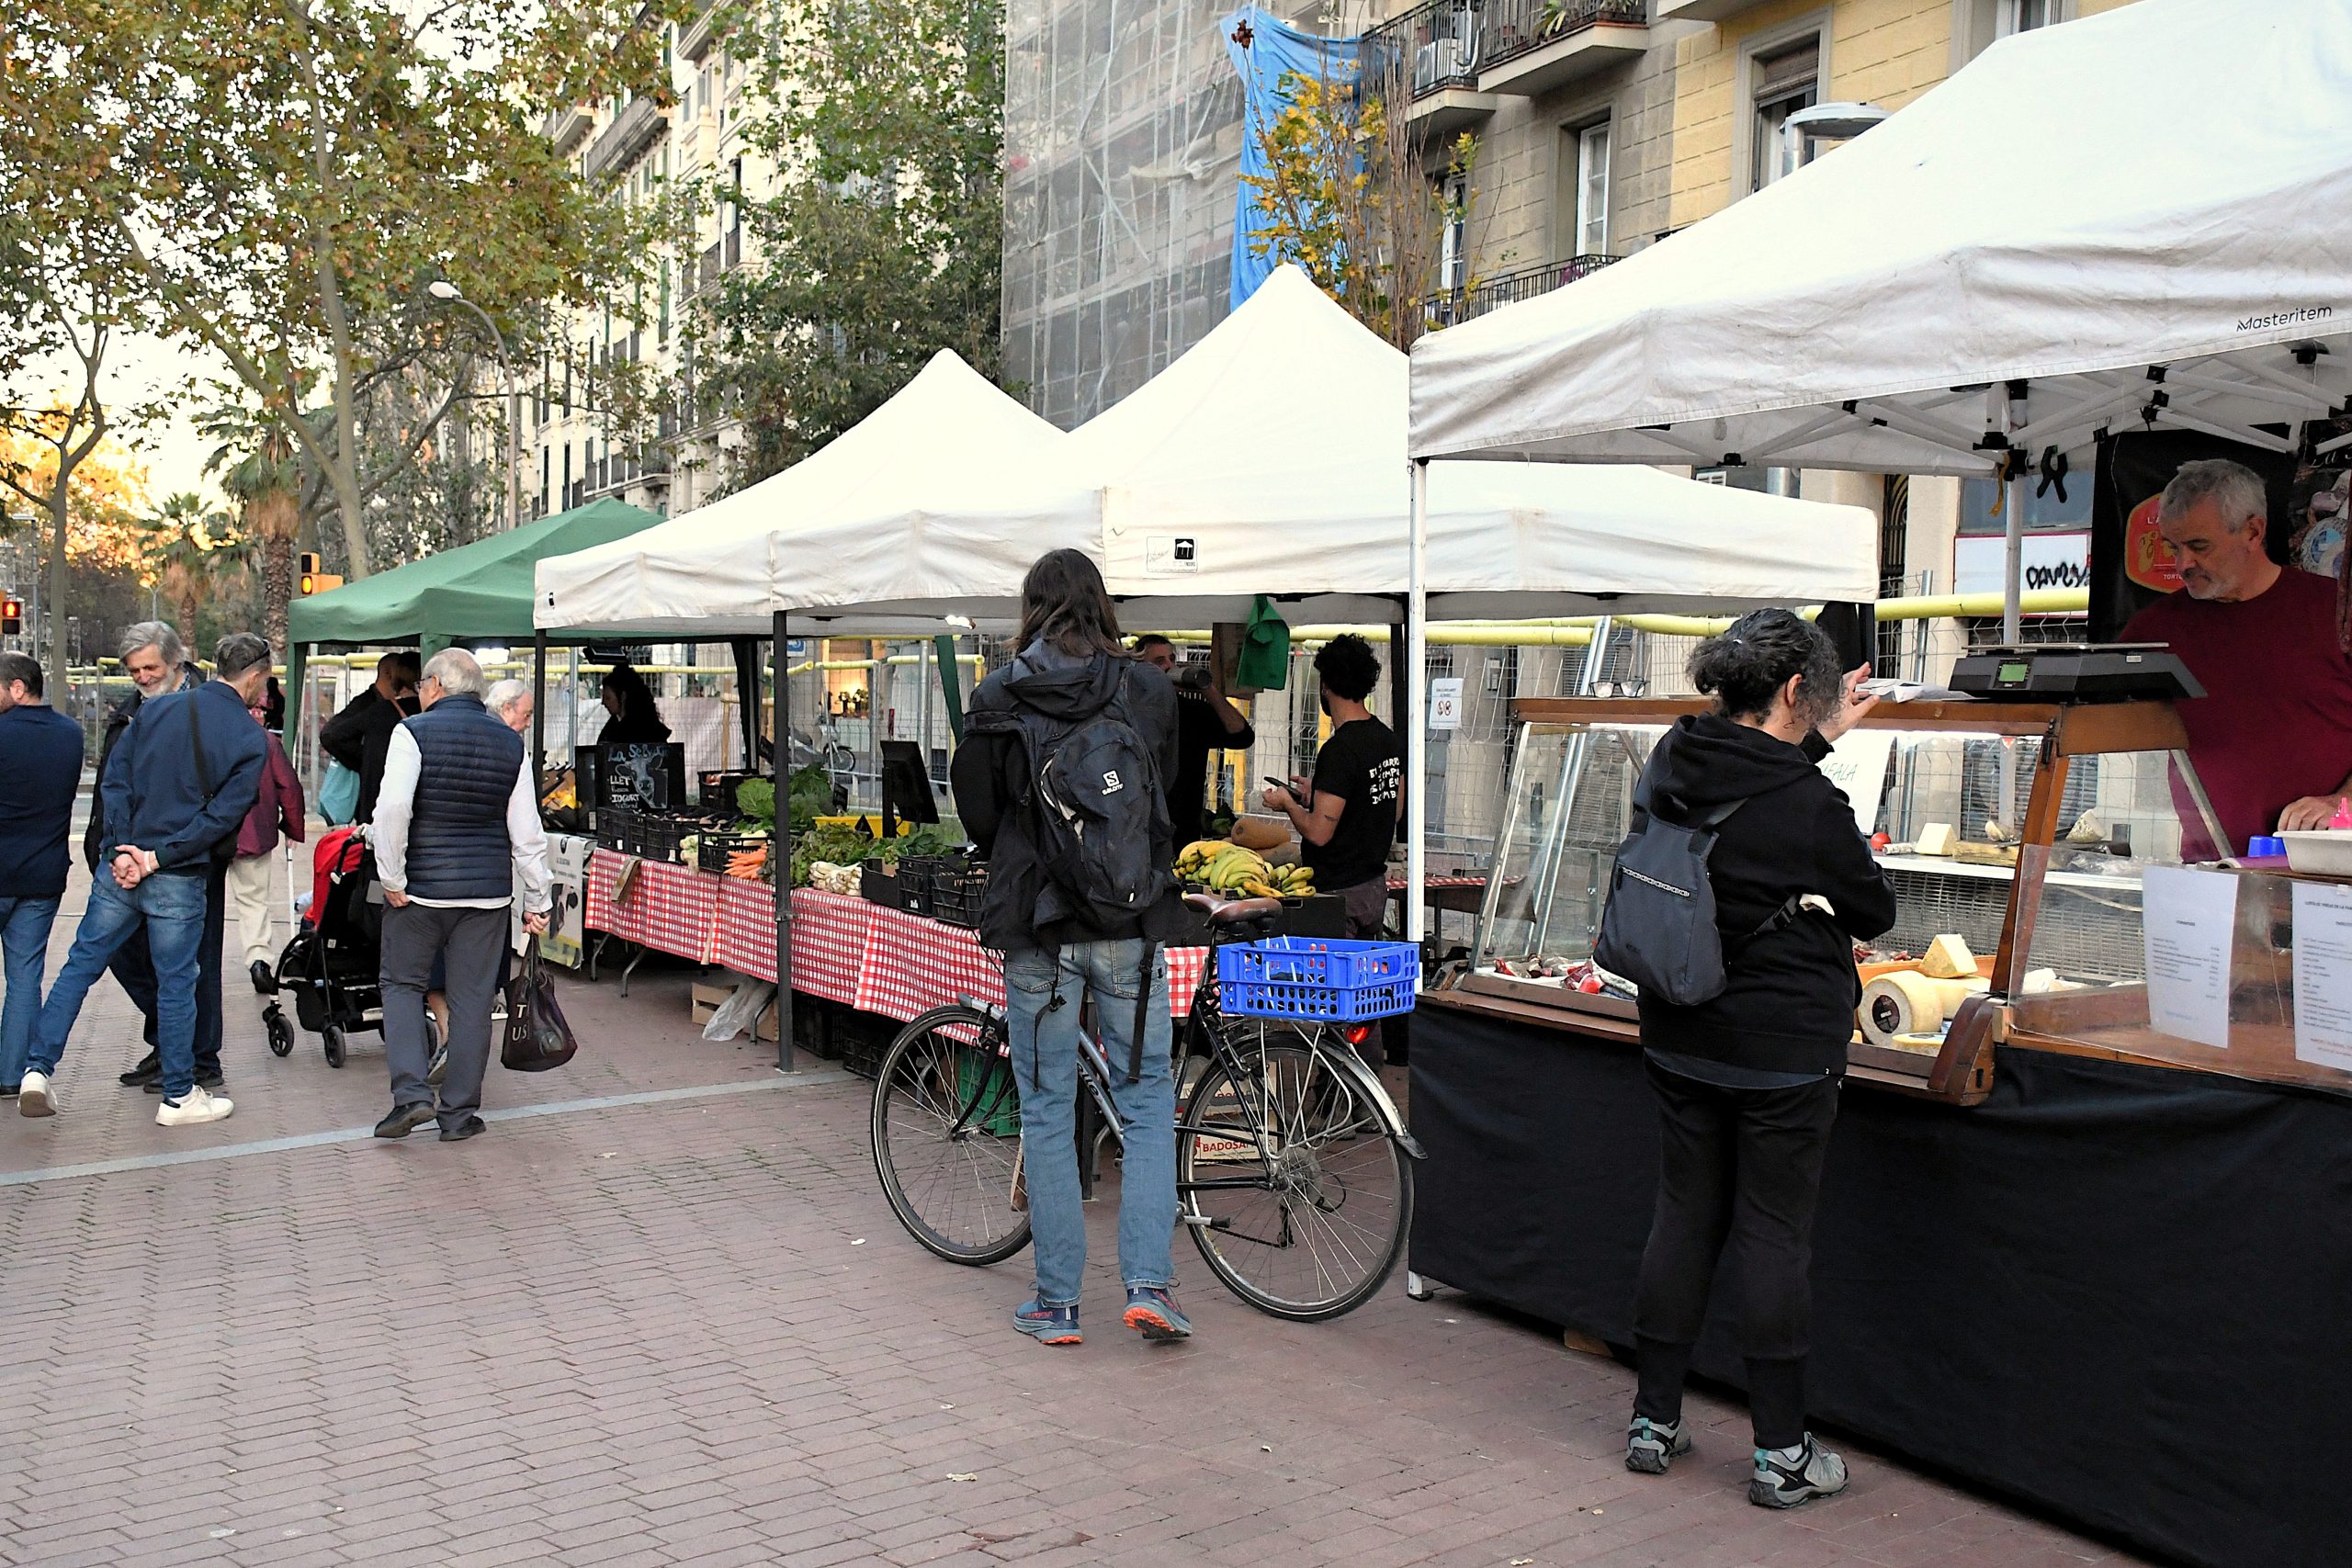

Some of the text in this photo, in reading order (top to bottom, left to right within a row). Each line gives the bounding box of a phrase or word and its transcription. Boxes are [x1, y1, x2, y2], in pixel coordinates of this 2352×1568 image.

[2236, 306, 2332, 333] Masteritem
[610, 775, 631, 786] LLET
[611, 794, 639, 803] IOGURT
